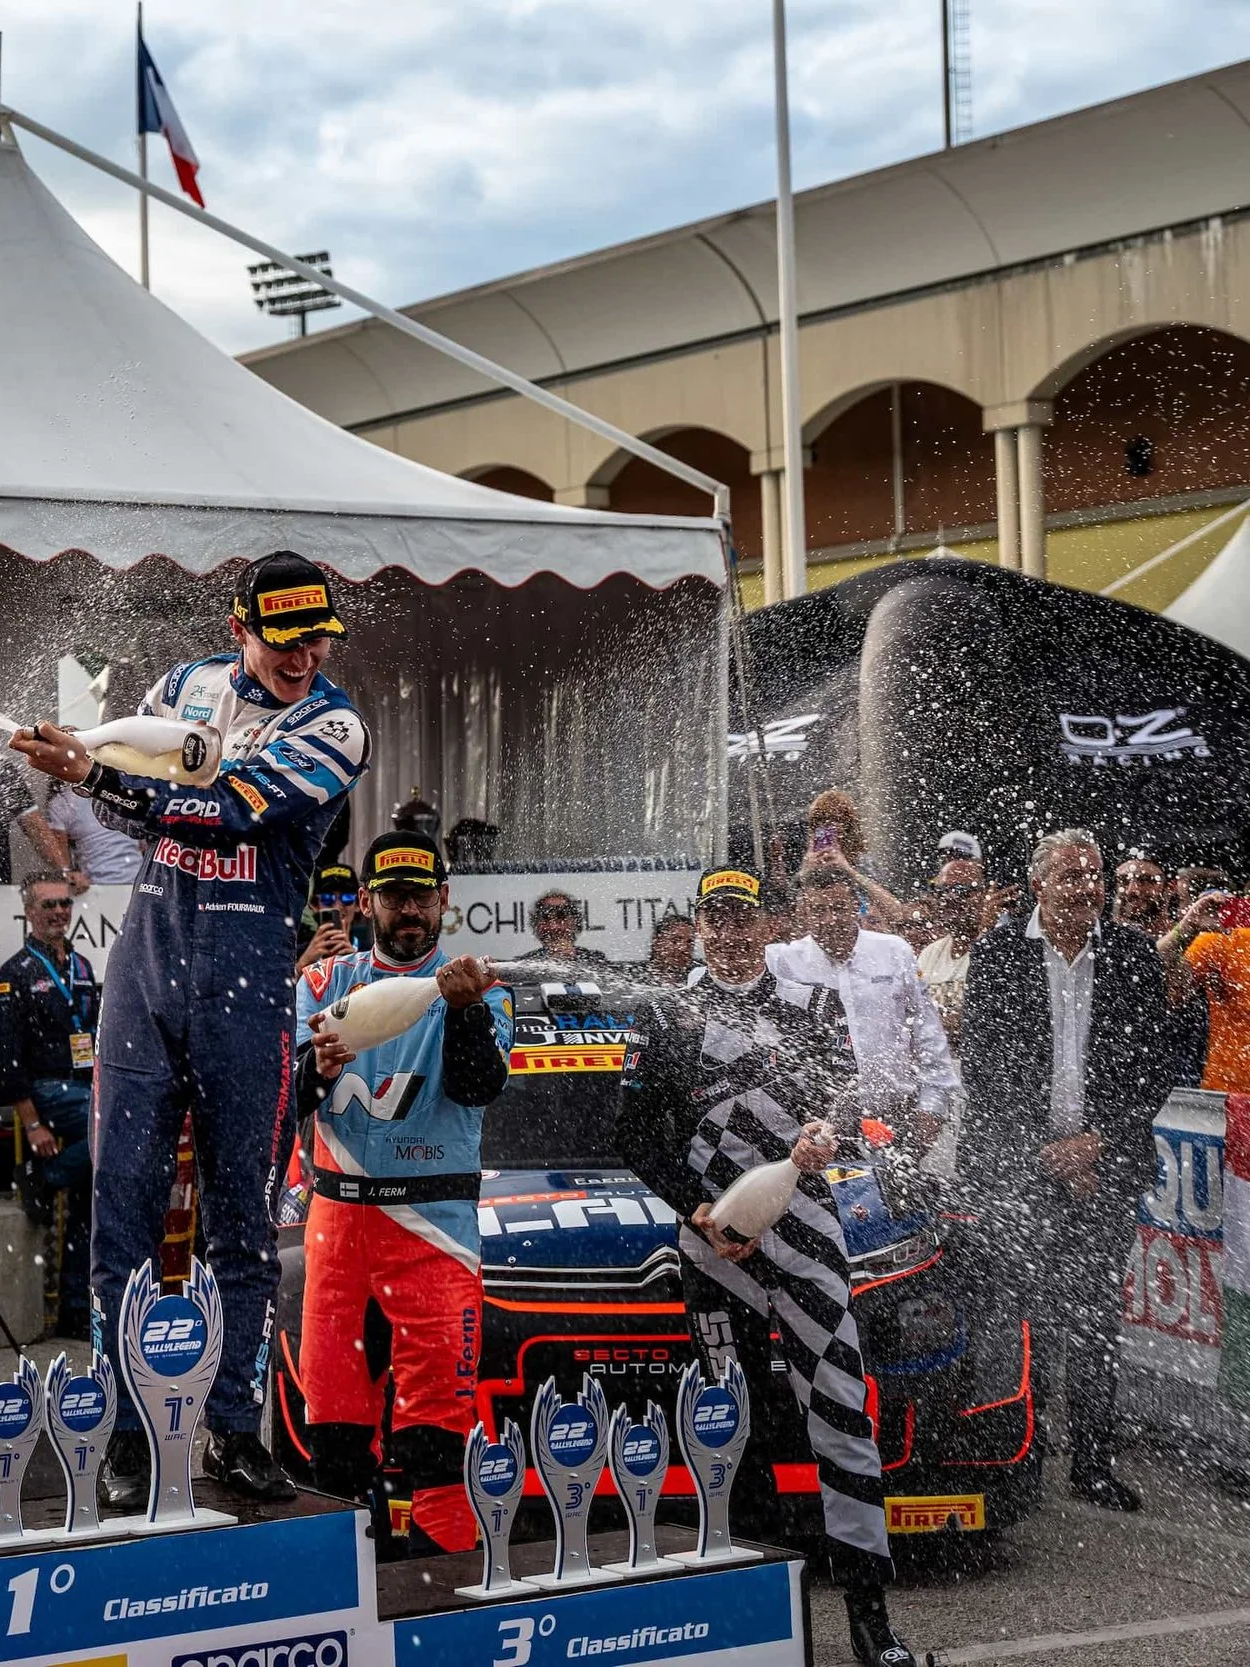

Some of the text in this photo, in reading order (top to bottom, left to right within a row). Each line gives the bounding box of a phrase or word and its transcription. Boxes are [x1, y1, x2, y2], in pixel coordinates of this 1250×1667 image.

[262, 589, 323, 612] PIRELLI
[183, 706, 212, 719] Nord
[286, 699, 329, 725] sparco
[282, 748, 312, 769] Ford
[100, 789, 139, 811] sparco
[230, 776, 268, 812] PIRELLI
[164, 799, 221, 817] FORD
[154, 837, 258, 883] Red Bull
[379, 850, 431, 868] PIRELLI
[139, 883, 165, 896] sparco
[205, 904, 266, 914] Adrien FOURMAUX
[509, 1048, 623, 1070] PIRE
[270, 1029, 291, 1165] PERFORMANCE
[395, 1145, 445, 1161] MOBIS
[367, 1186, 407, 1197] J. FERM
[143, 1341, 203, 1354] RALLYLEGEND
[573, 1348, 669, 1362] SECTO
[102, 1581, 270, 1622] Classificato
[566, 1621, 710, 1659] Classificato
